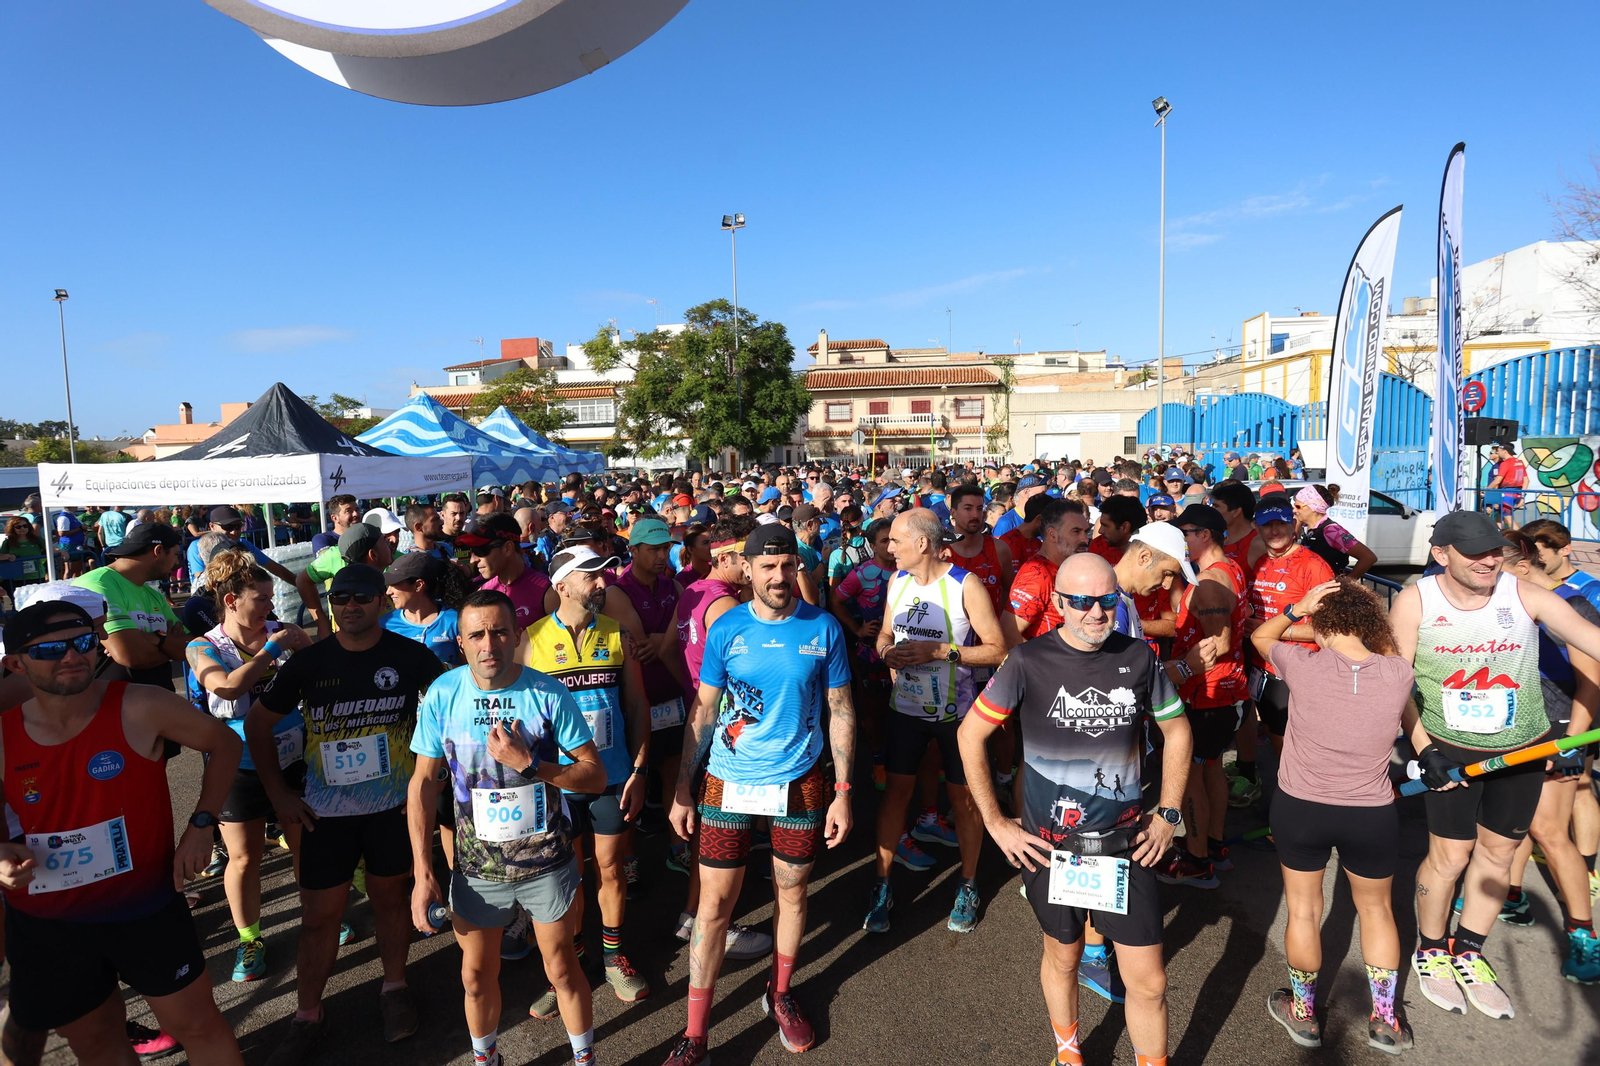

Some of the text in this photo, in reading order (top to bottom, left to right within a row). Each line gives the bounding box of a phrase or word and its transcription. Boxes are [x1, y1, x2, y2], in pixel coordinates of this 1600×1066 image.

[85, 474, 306, 493] Equipaciones deportivas personalizadas
[1433, 638, 1522, 654] maratón
[902, 681, 924, 695] 545
[311, 695, 406, 722] LA QUEDADA
[474, 697, 516, 711] TRAIL
[651, 705, 672, 719] 879
[1457, 703, 1495, 718] 952
[474, 716, 515, 727] FACINAS
[1059, 717, 1130, 727] TRAIL
[278, 741, 296, 756] 40
[377, 736, 389, 775] PIRATILLA
[92, 762, 121, 775] GADIRA
[334, 752, 367, 770] 519
[486, 804, 523, 823] 906
[535, 785, 543, 830] PIRATILLA
[114, 821, 128, 869] PIRATILLA
[45, 846, 94, 871] 675
[1064, 869, 1102, 890] 905
